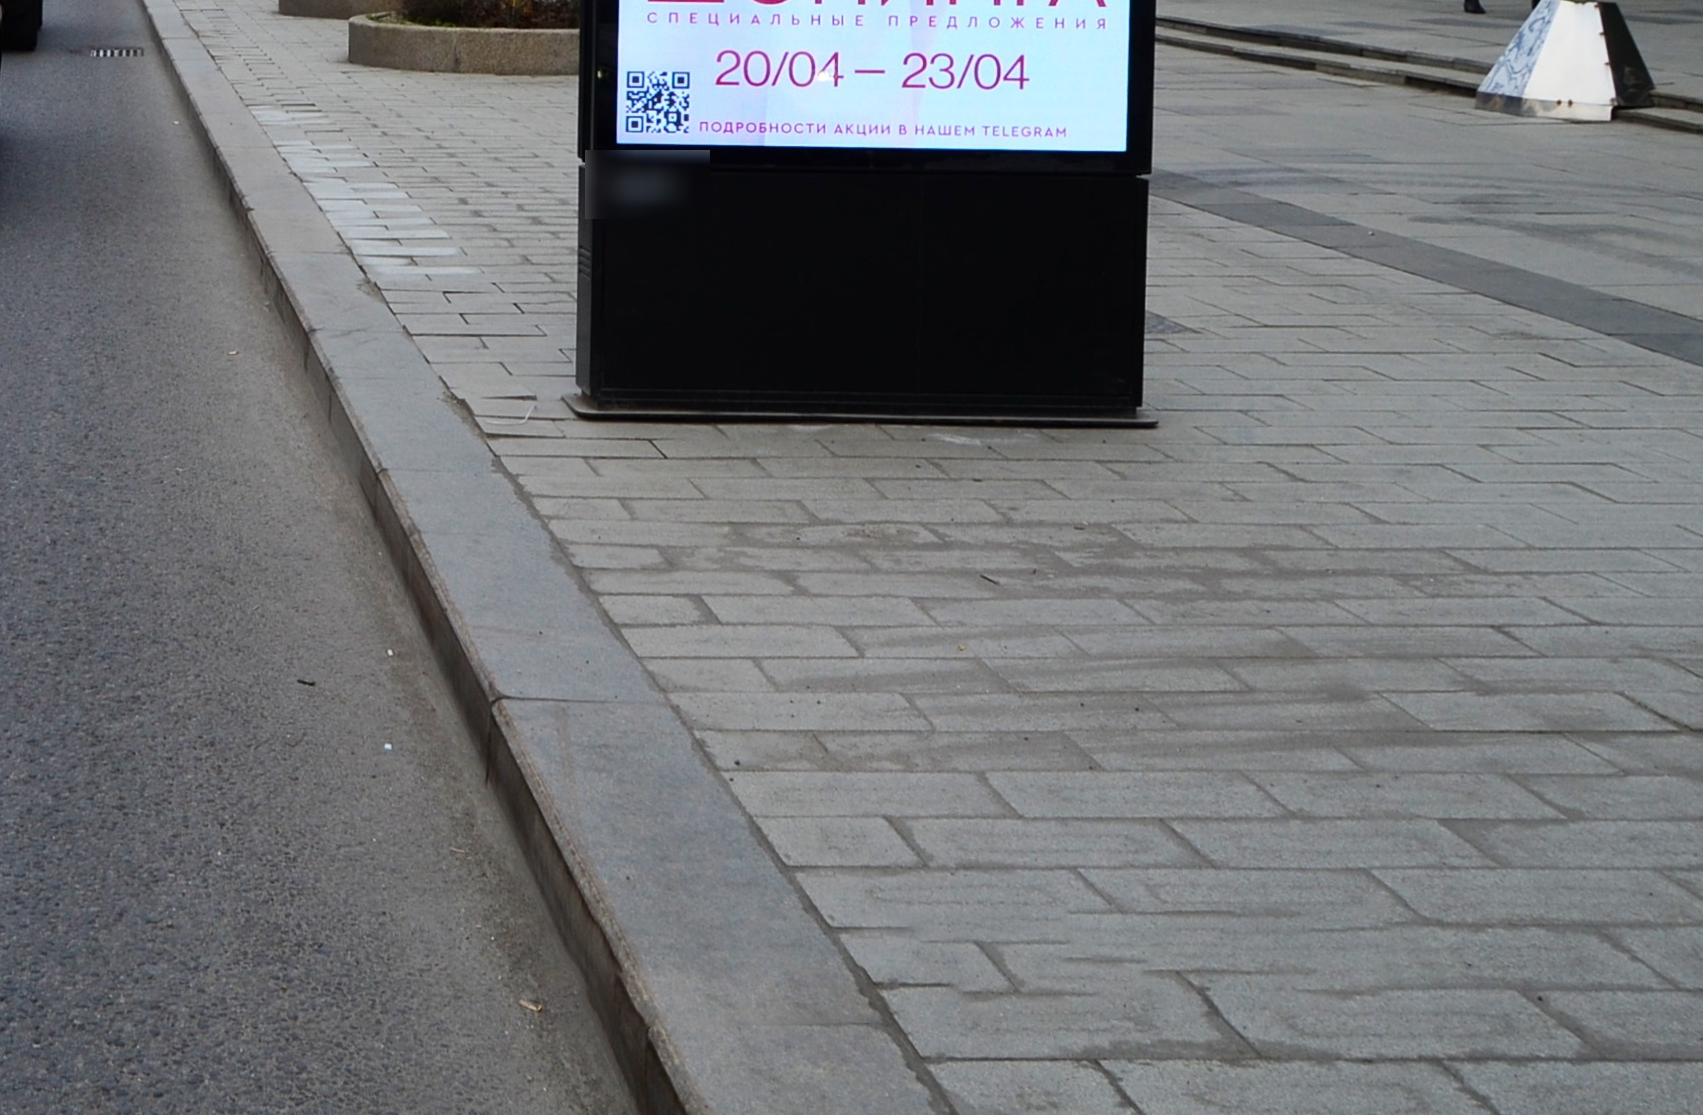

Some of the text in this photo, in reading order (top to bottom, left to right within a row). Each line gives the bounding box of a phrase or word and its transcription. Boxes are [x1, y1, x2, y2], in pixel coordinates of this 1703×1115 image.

[647, 12, 1107, 30] СПЕЦИАЛЬНЫЕ ПРЕДЛОЖЕНИЯ
[715, 49, 844, 88] 20/04
[901, 52, 1030, 90] 23/04
[699, 121, 1068, 138] ПОДРОБНОСТИ АКЦИИ В НАШЕМ TELEGRAM
